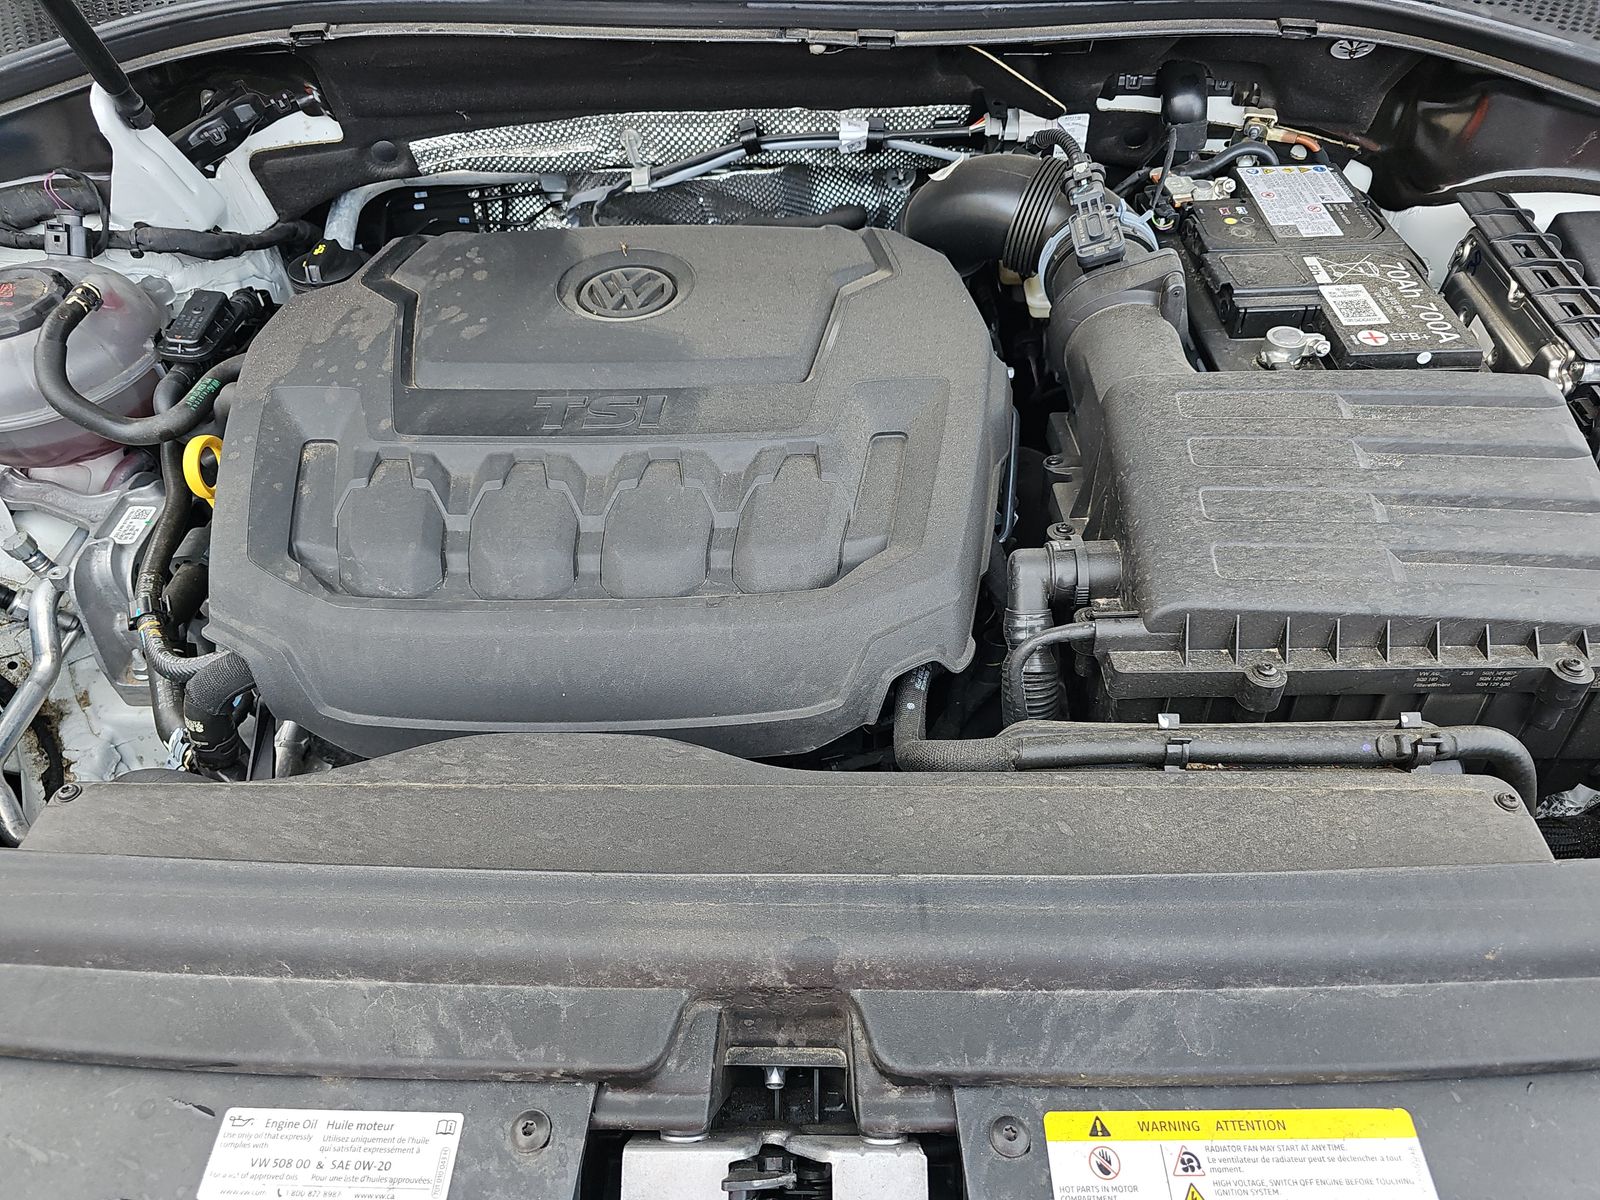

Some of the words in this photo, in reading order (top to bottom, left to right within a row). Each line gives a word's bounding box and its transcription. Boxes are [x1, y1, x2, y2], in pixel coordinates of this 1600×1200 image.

[1380, 262, 1422, 298] 70Ah
[1412, 302, 1461, 344] 700A
[1390, 333, 1431, 342] EFB+
[533, 394, 668, 429] TSI
[265, 1118, 300, 1131] Engine
[302, 1119, 318, 1129] Oil
[326, 1120, 354, 1130] Huile
[356, 1122, 396, 1131] moteur
[1137, 1120, 1200, 1132] WARNING
[1216, 1120, 1286, 1131] ATTENTION
[238, 1132, 252, 1140] only
[280, 1134, 313, 1142] expressly
[320, 1145, 333, 1153] qui
[364, 1146, 414, 1154] expressément
[251, 1158, 271, 1168] VW
[272, 1158, 293, 1168] 508
[296, 1159, 311, 1168] 00
[316, 1160, 324, 1169] &
[330, 1160, 351, 1170] SAE
[354, 1160, 392, 1171] 0W-20
[1308, 1156, 1326, 1164] peut
[360, 1175, 388, 1183] d'huiles
